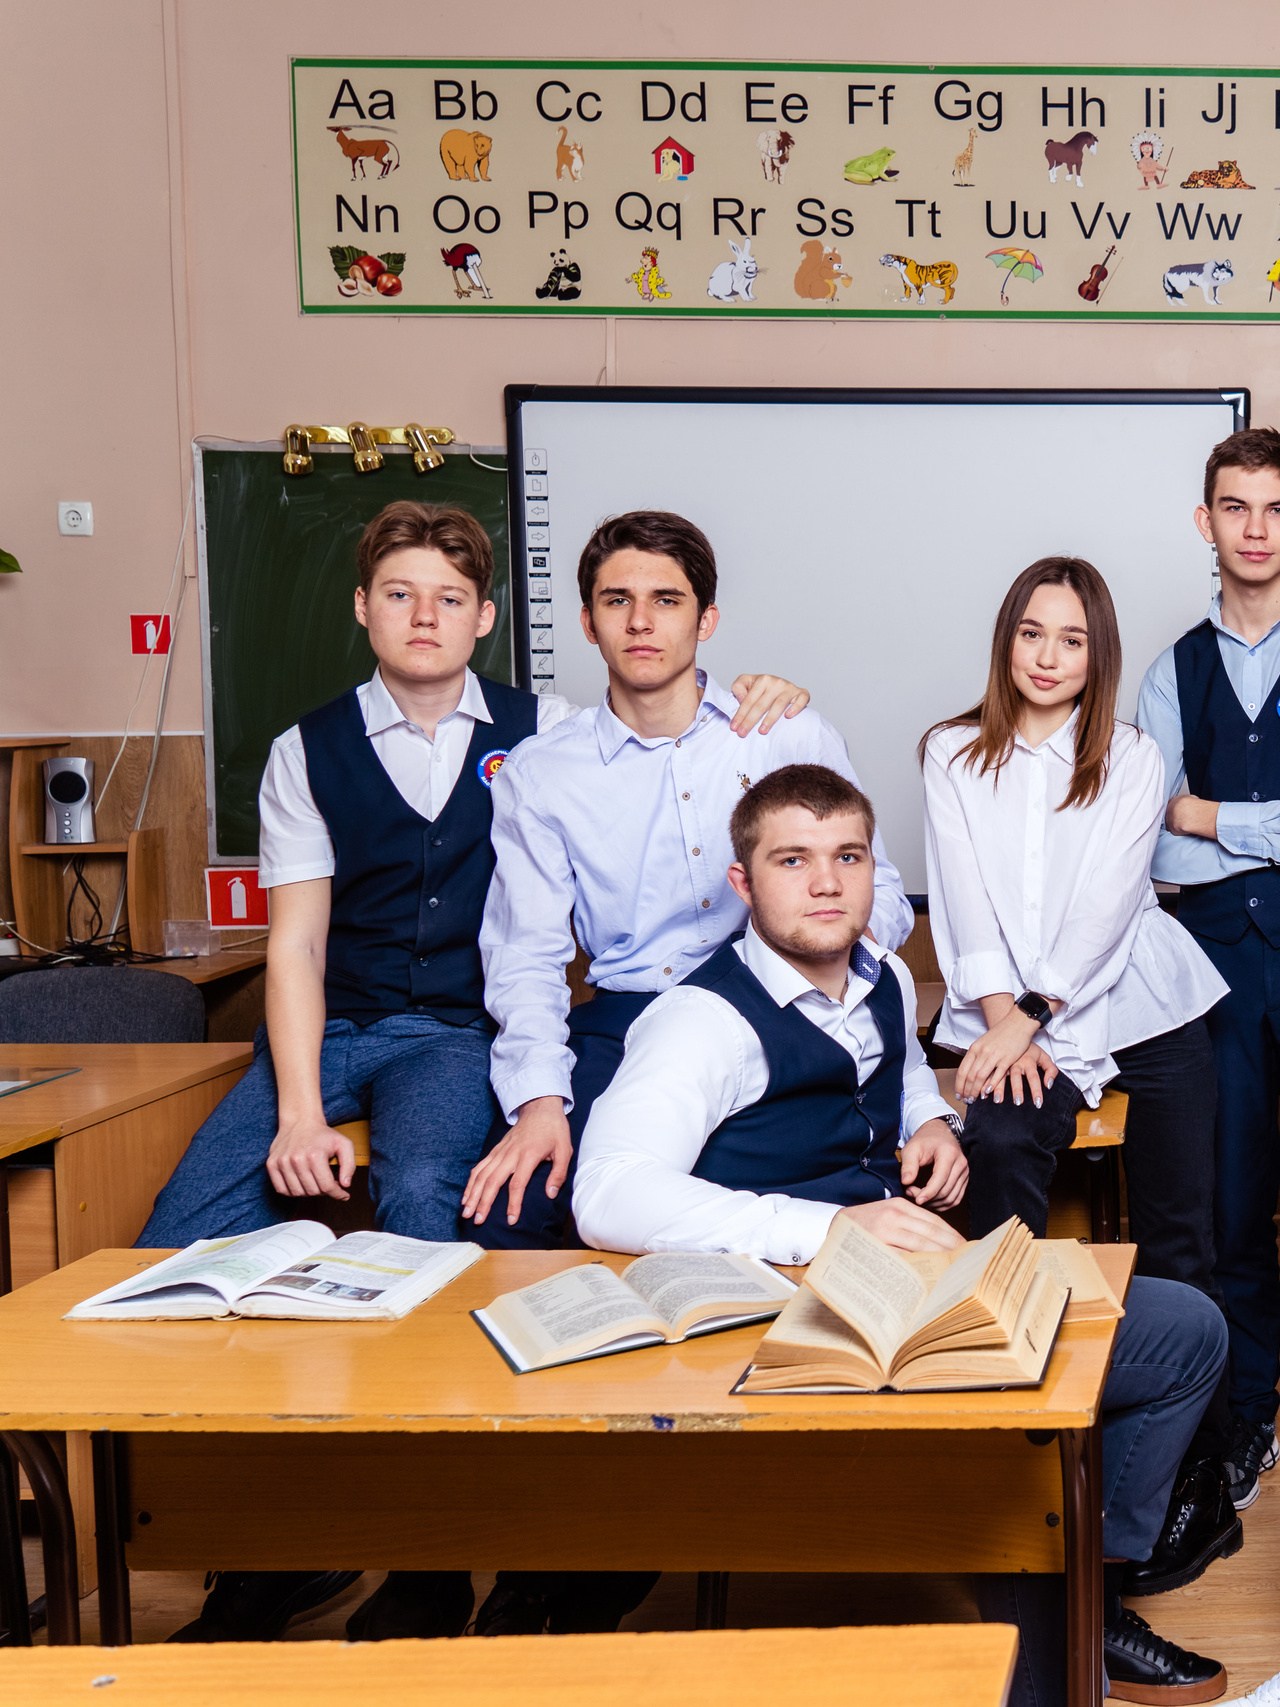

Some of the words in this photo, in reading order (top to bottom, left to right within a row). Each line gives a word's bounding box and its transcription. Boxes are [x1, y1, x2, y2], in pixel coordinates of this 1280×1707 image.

[328, 79, 395, 121] Aa
[434, 80, 498, 121] Bb
[536, 81, 602, 122] Cc
[641, 81, 706, 122] Dd
[745, 82, 808, 123] Ee
[848, 85, 895, 125] Ff
[935, 80, 1002, 132] Gg
[1042, 87, 1105, 127] Hh
[1146, 88, 1164, 127] Ii
[1202, 83, 1236, 134] Jj
[336, 195, 399, 233] Nn
[433, 195, 500, 234] Oo
[529, 191, 588, 239] Pp
[616, 192, 681, 240] Qq
[713, 198, 766, 235] Rr
[796, 198, 854, 237] Ss
[895, 200, 941, 238] Tt
[986, 201, 1046, 239] Uu
[1071, 202, 1130, 239] Vv
[1156, 203, 1242, 240] Ww
